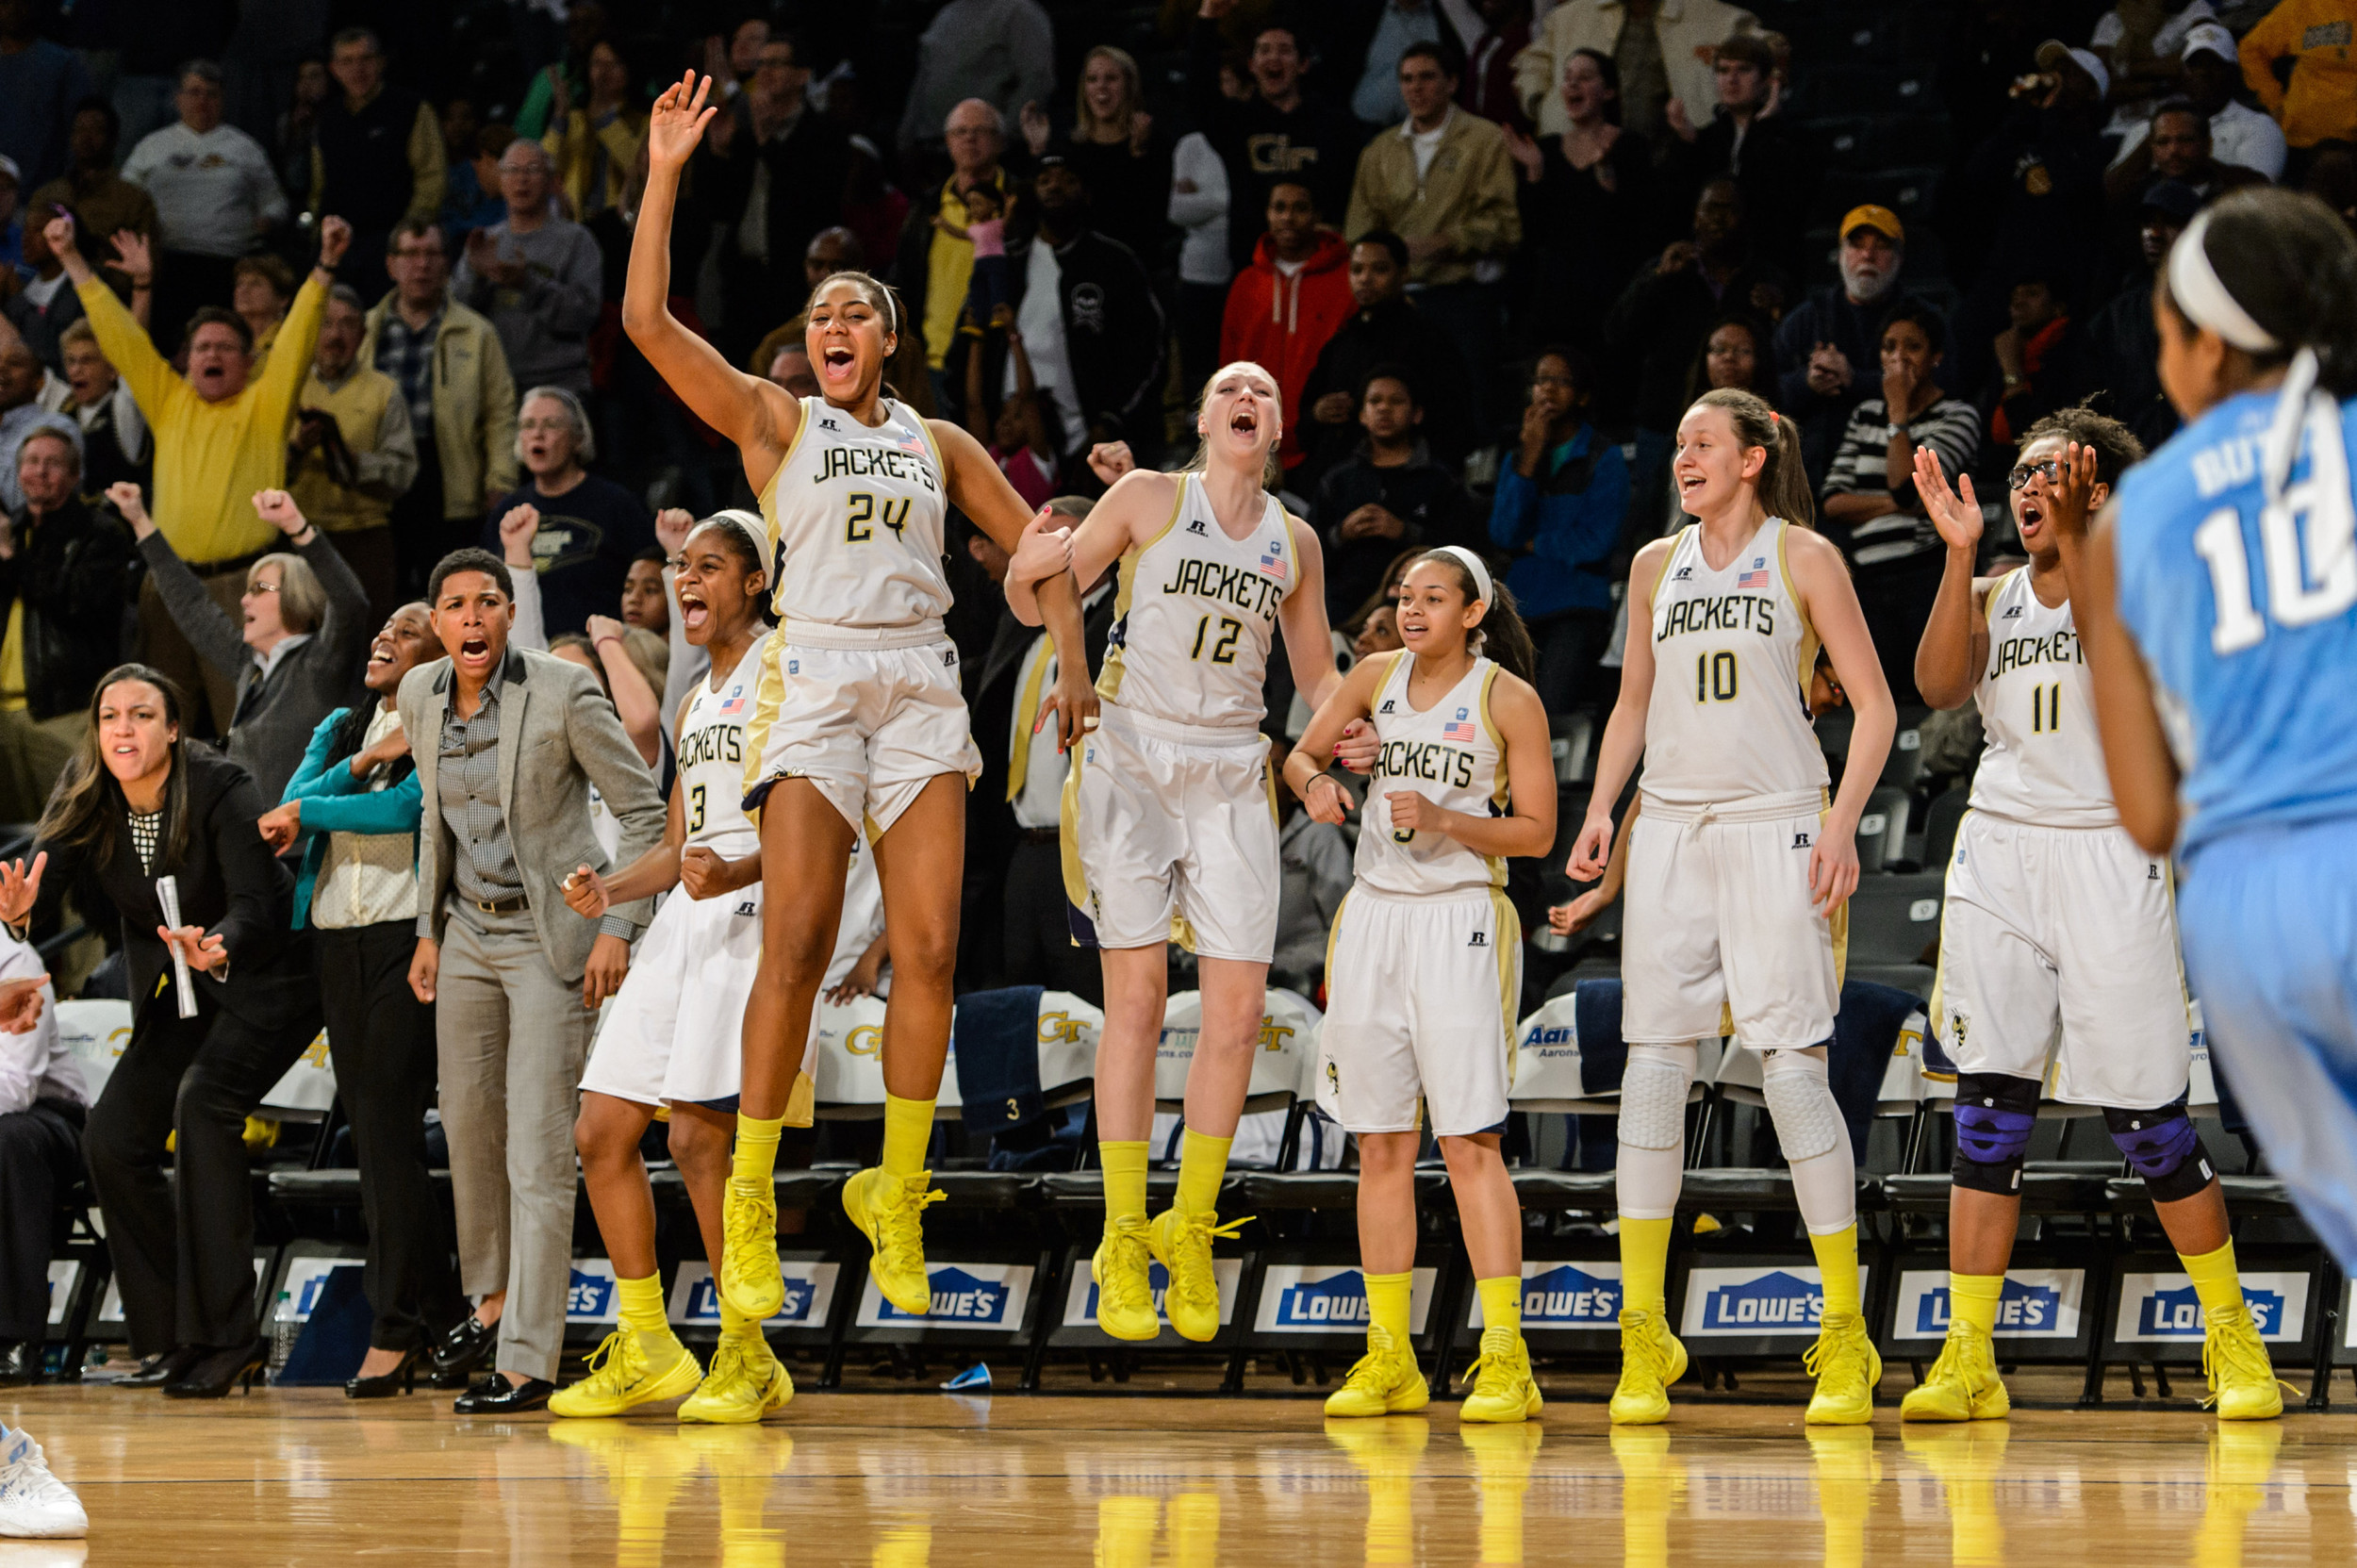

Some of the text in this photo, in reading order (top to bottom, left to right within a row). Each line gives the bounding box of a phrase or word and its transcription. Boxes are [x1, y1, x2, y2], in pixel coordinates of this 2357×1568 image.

[814, 448, 935, 492] JACKETS
[845, 490, 913, 544] 24
[1163, 558, 1284, 622] JACKETS
[1191, 613, 1243, 666] 12
[1656, 595, 1774, 643] JACKETS
[1697, 649, 1739, 705] 10
[1989, 631, 2083, 681] JACKET
[2032, 681, 2062, 735] 11
[678, 723, 743, 778] ACKETS
[689, 781, 707, 834] 3
[1037, 1010, 1091, 1044] GT
[1519, 1024, 1576, 1049] Aar
[1006, 1098, 1021, 1120] 3
[891, 1288, 996, 1318] WE'S
[1291, 1292, 1371, 1321] LOWE
[1520, 1288, 1613, 1318] OWE'S
[1717, 1293, 1824, 1323] LOWE'S
